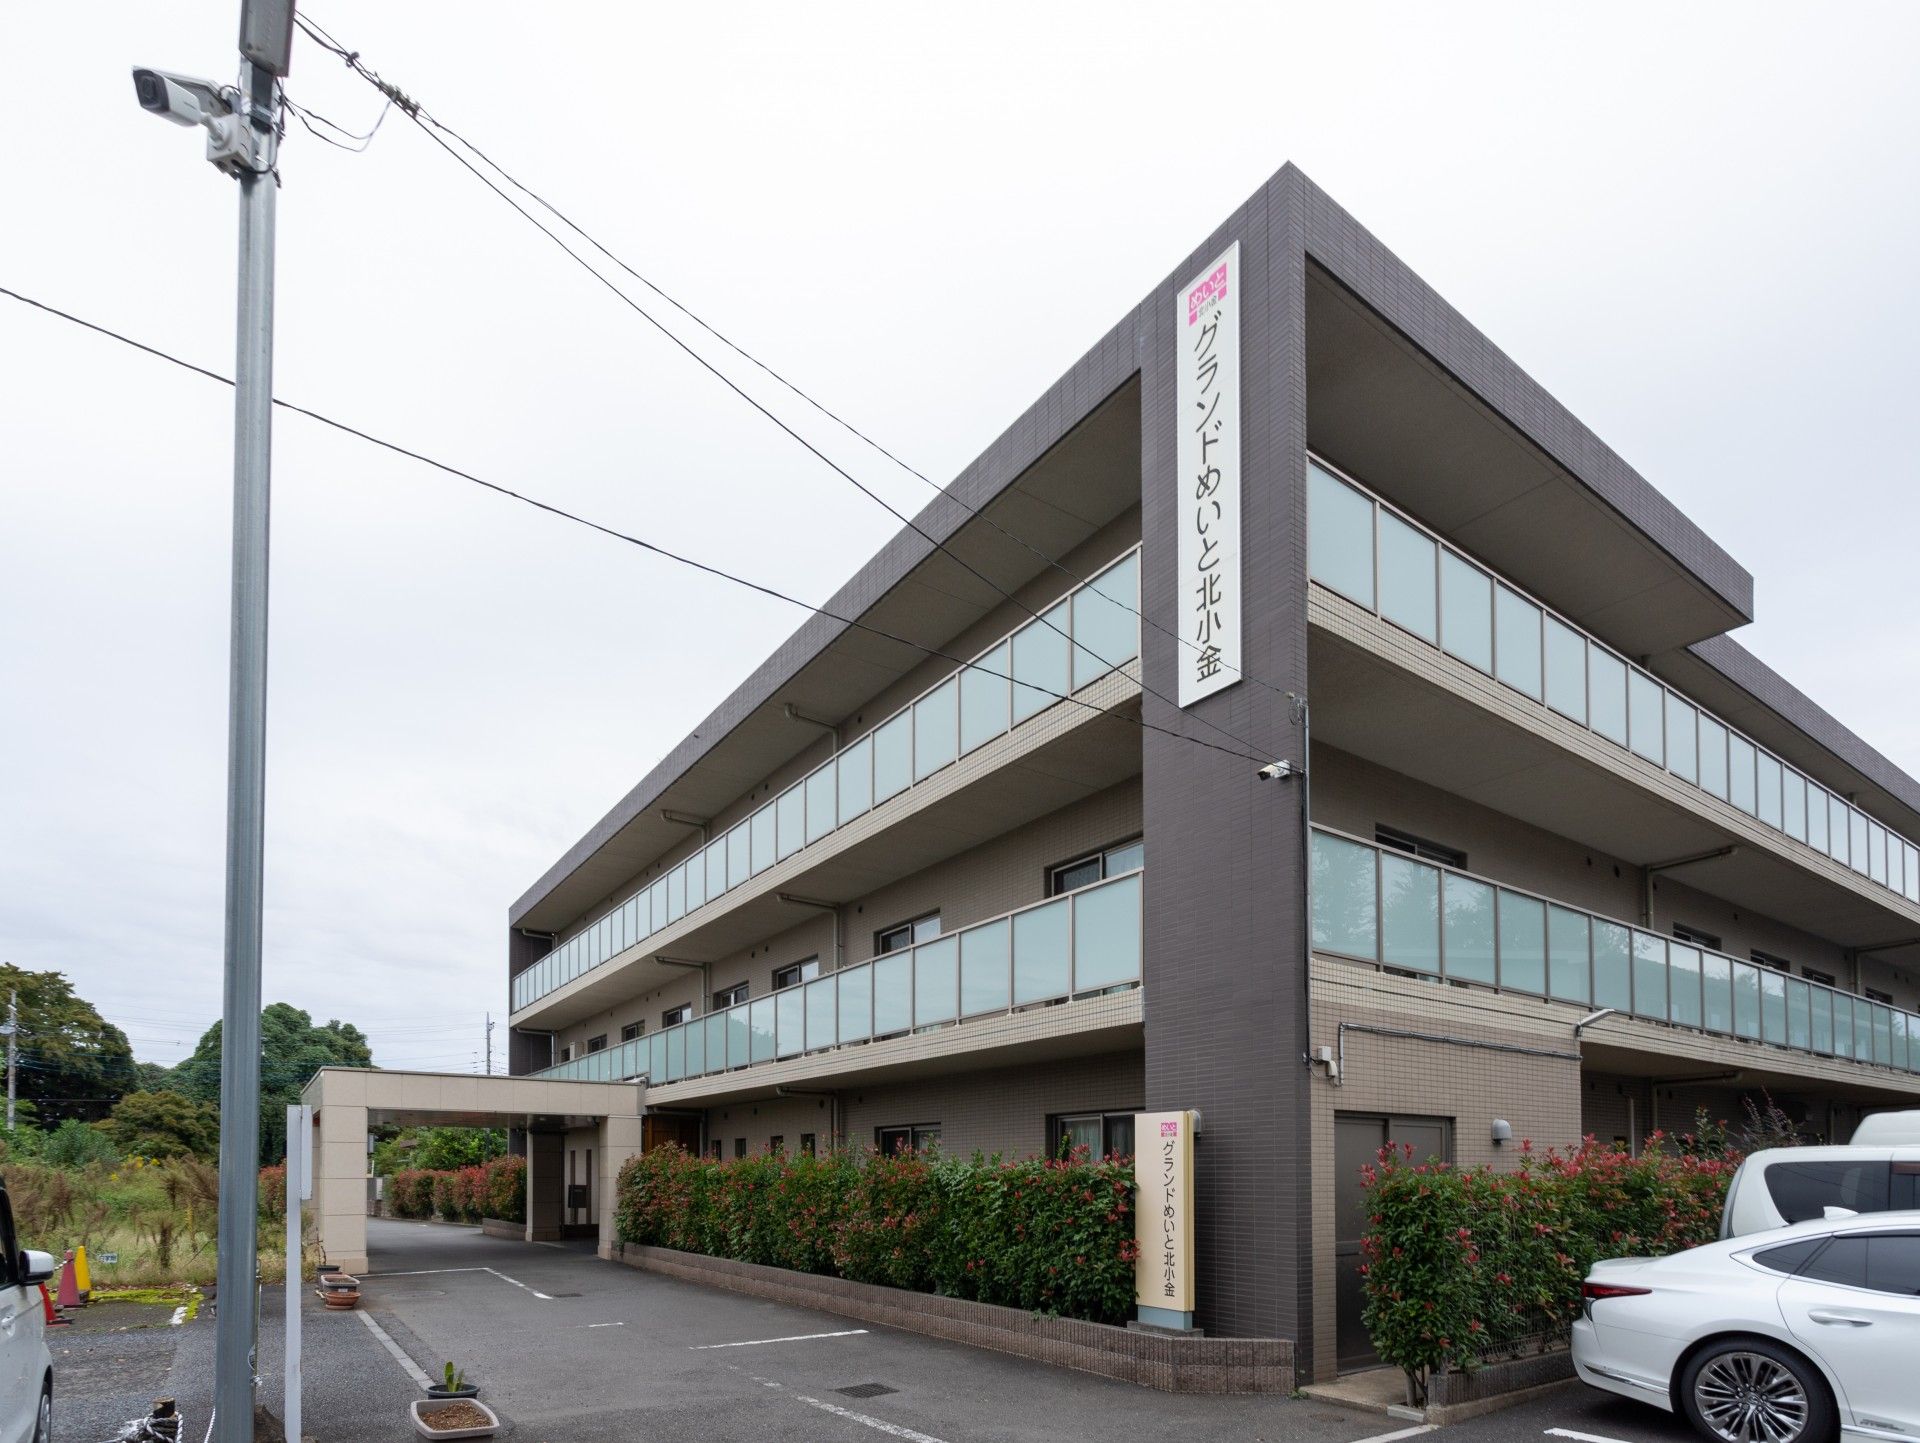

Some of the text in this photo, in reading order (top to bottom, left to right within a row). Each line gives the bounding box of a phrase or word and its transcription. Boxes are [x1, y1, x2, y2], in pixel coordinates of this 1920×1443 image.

[1190, 271, 1225, 310] めいと
[1194, 310, 1223, 682] グランドめいと北小金
[1163, 1140, 1175, 1297] グランドめいと北小金
